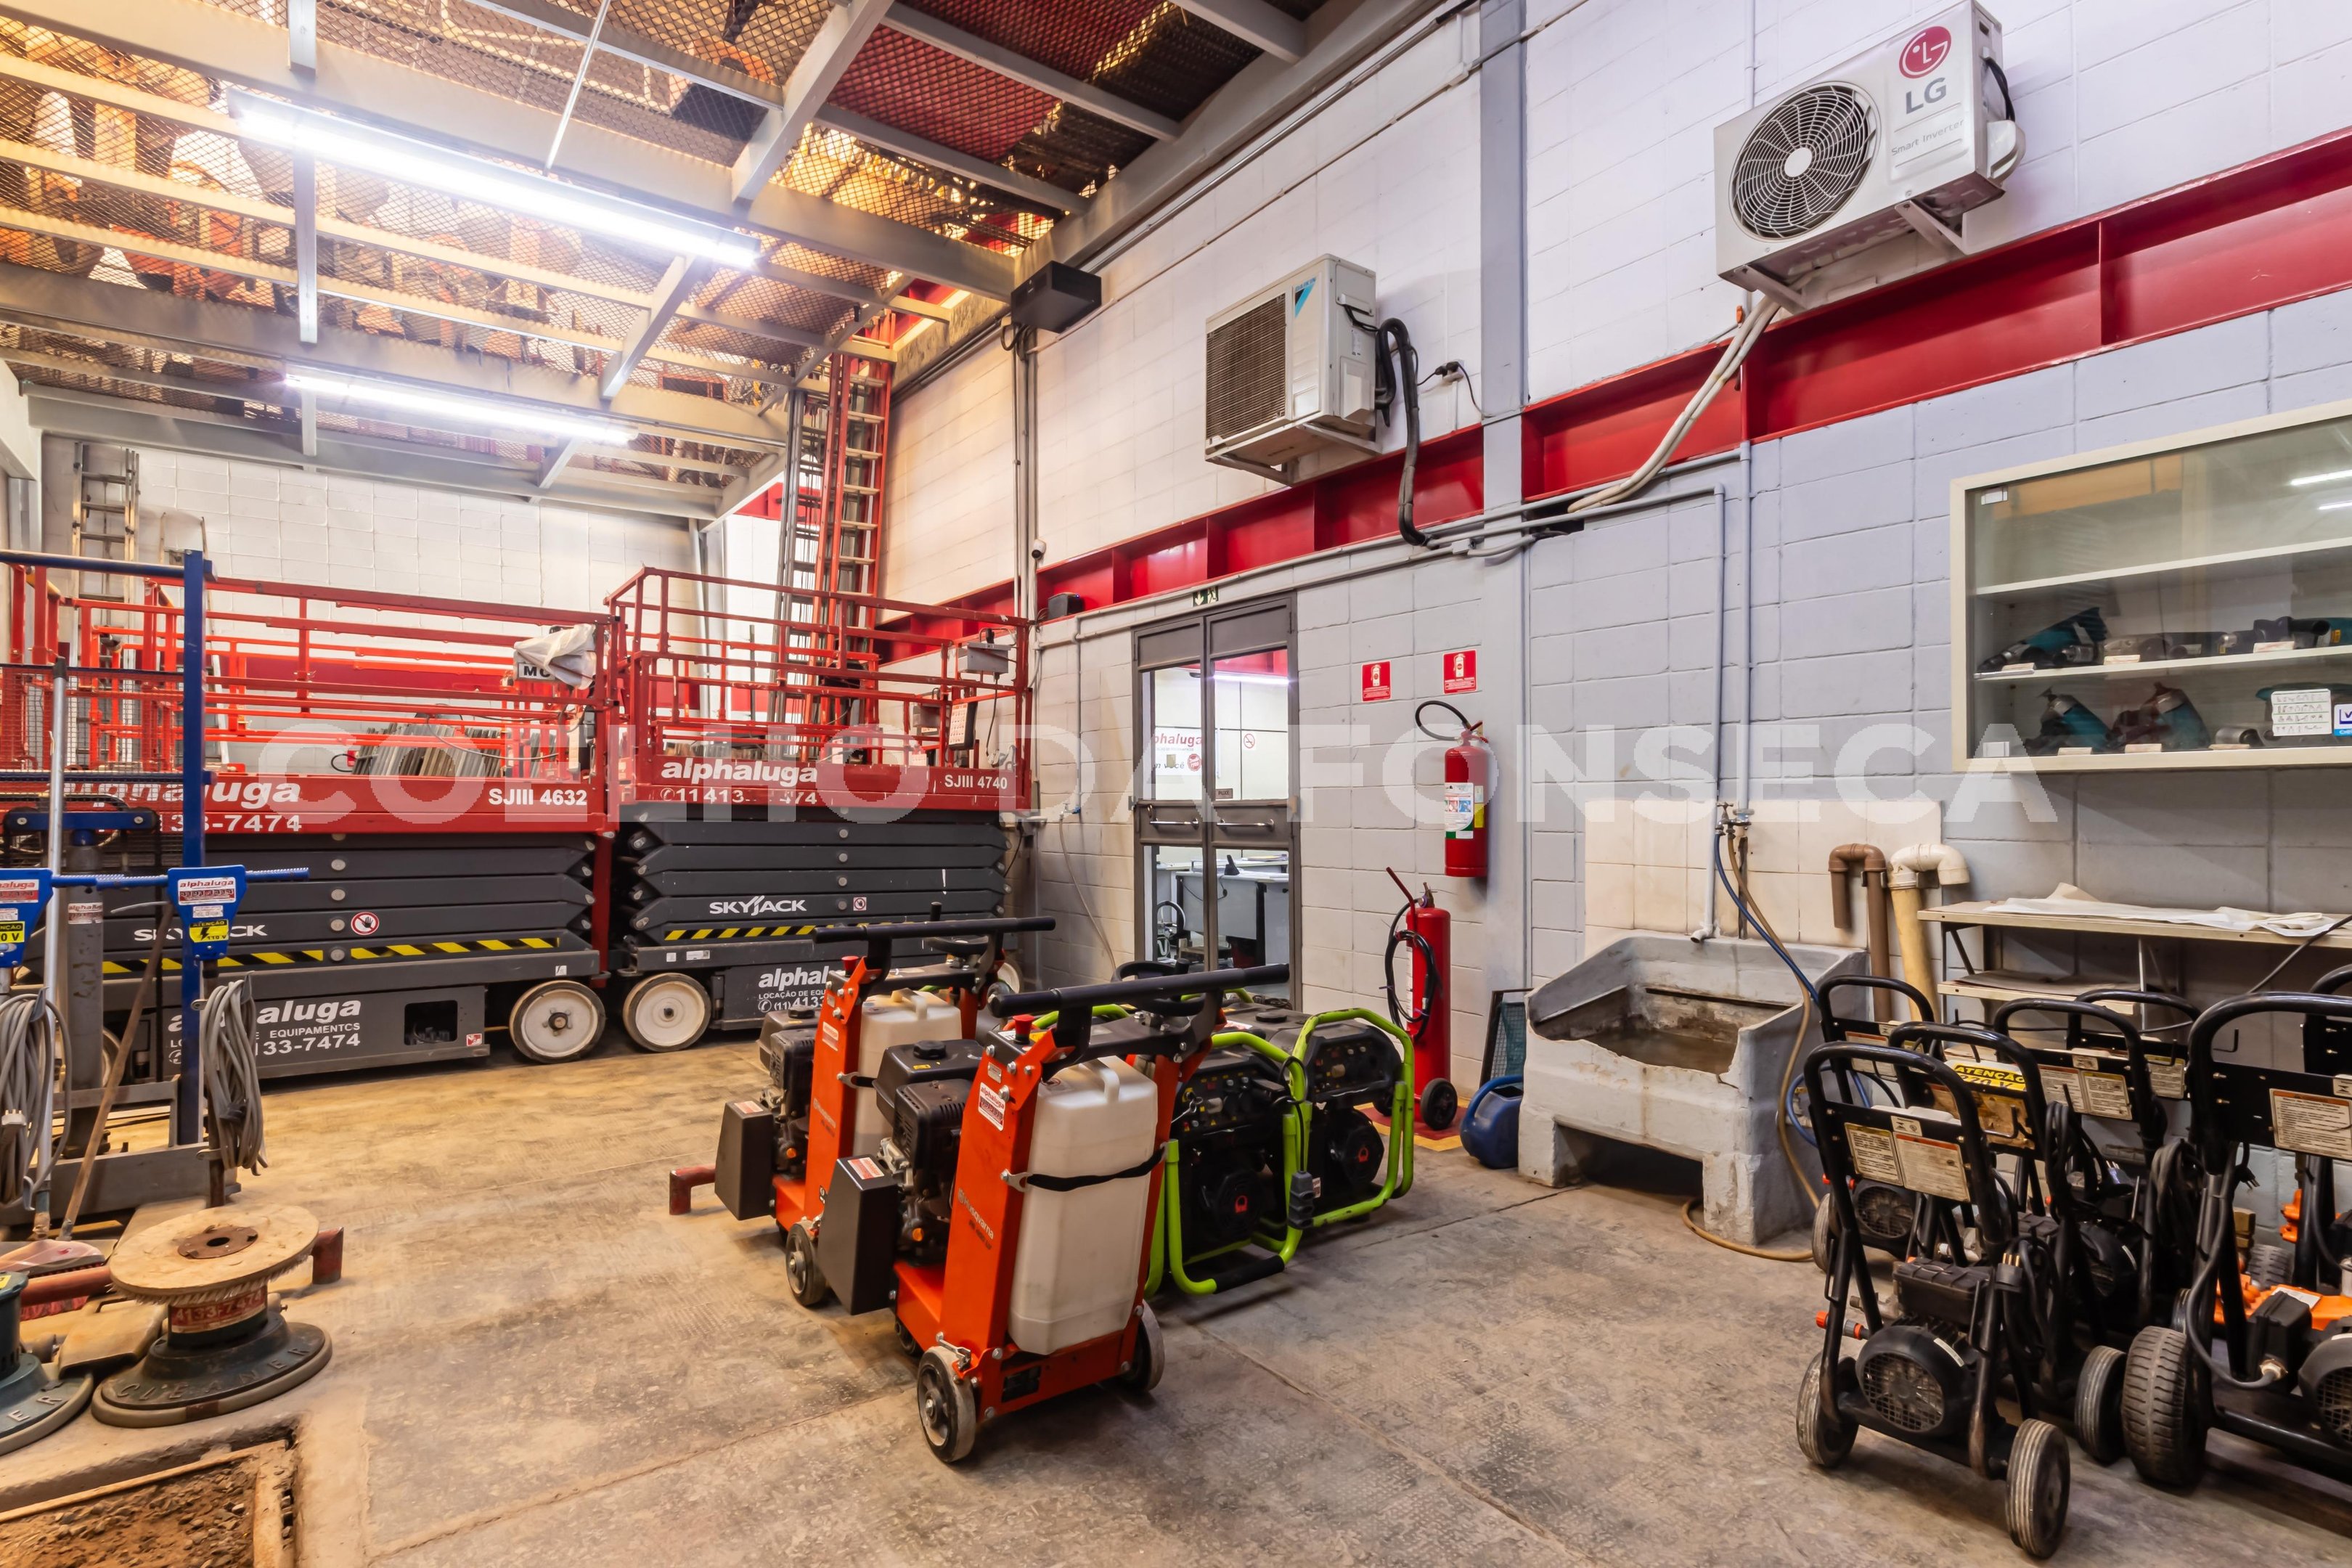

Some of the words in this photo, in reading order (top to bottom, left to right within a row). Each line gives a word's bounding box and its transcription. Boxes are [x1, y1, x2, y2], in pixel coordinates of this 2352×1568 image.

[1906, 77, 1947, 115] LG
[1891, 139, 1919, 156] Smart
[1922, 119, 1964, 142] Inverter
[661, 758, 817, 787] alphaluga
[944, 775, 973, 788] SJIII
[977, 776, 1008, 790] 4740
[489, 788, 534, 805] SJIII
[540, 790, 587, 806] 4632
[709, 895, 807, 916] SKYJACK
[12, 932, 20, 941] V
[759, 990, 796, 1000] LOCAÇÃO
[774, 1001, 791, 1010] (11)
[1954, 1066, 2026, 1084] ATENÇÃO
[981, 1087, 1005, 1110] alphaluga
[963, 1196, 994, 1240] Husqvarna
[116, 1347, 310, 1401] CLEANER
